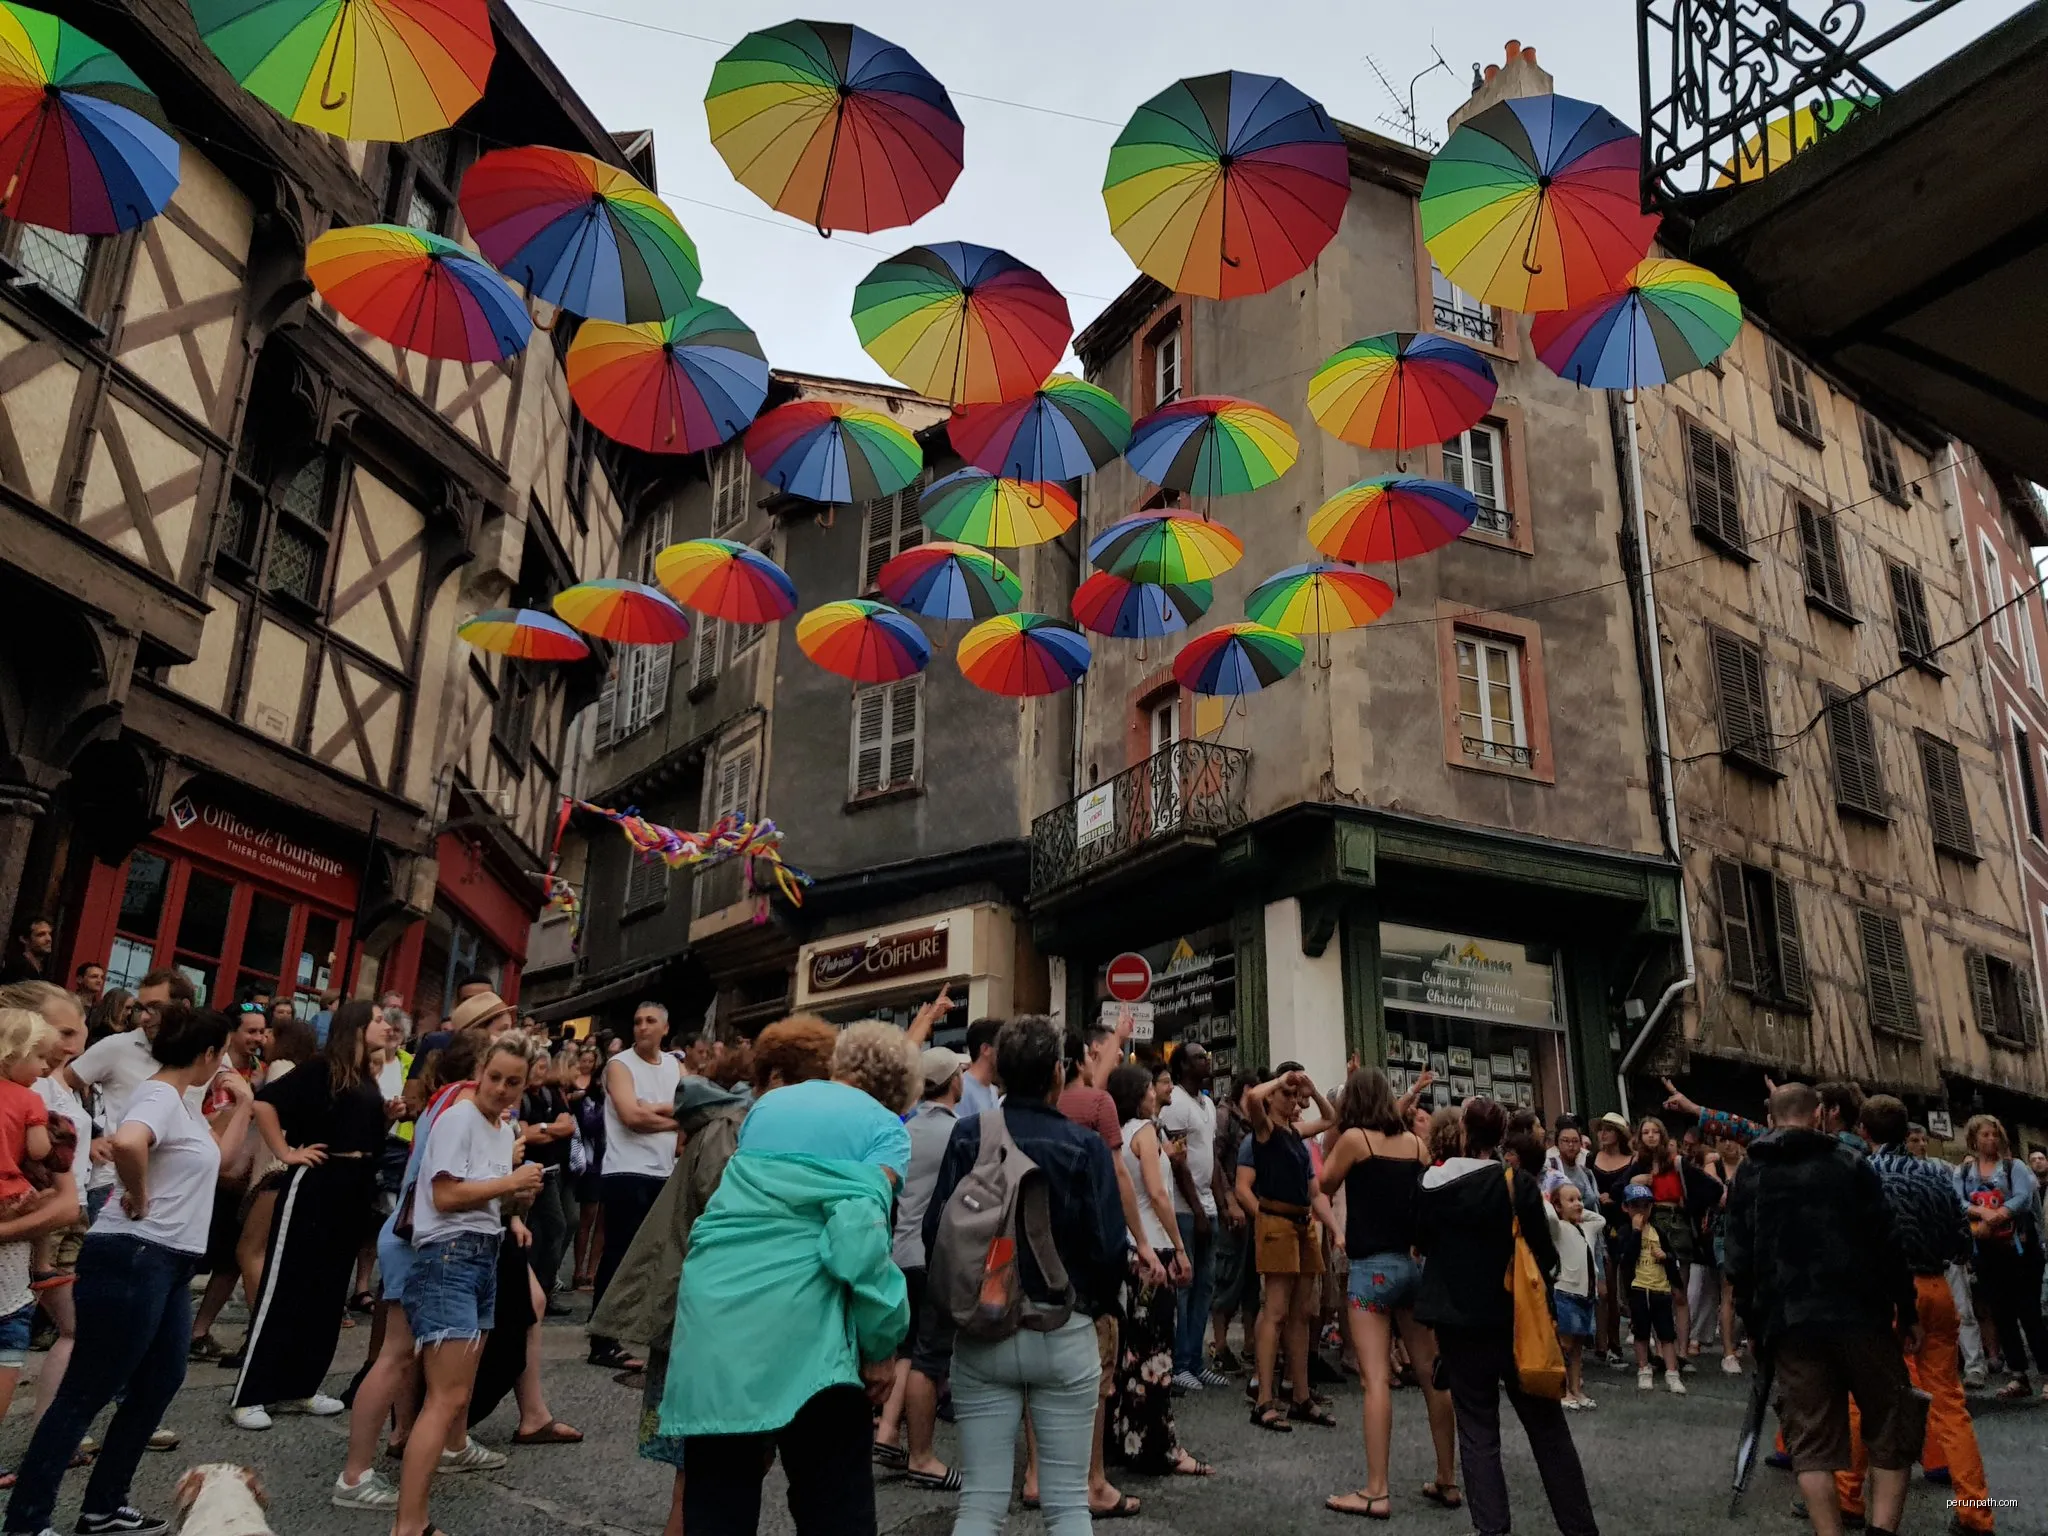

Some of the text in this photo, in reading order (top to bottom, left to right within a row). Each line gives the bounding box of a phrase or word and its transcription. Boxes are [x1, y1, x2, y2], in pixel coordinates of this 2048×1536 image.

[203, 804, 343, 878] Office de Tourisme
[227, 840, 318, 884] THIERS COMMUNAUTÉ
[1150, 972, 1215, 1001] Cabinet Immobilier
[1422, 970, 1519, 999] Cabinet Immobilier
[1427, 989, 1482, 1012] Christophe
